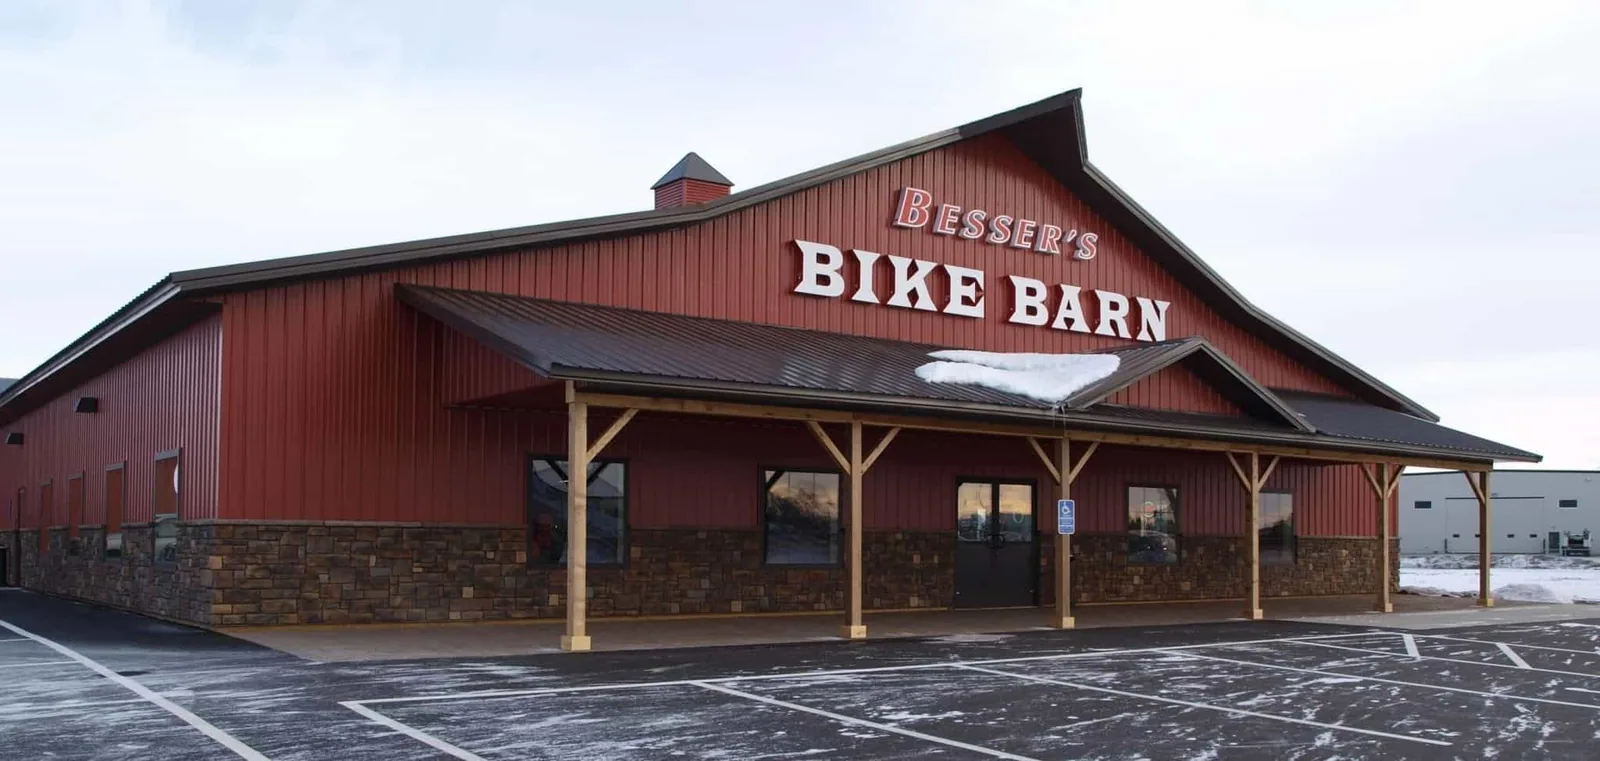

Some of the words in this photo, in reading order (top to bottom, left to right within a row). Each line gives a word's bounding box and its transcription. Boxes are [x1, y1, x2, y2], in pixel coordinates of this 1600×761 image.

[895, 187, 1098, 260] BESSER'S
[794, 239, 984, 318] BIKE
[1008, 275, 1171, 342] BARN
